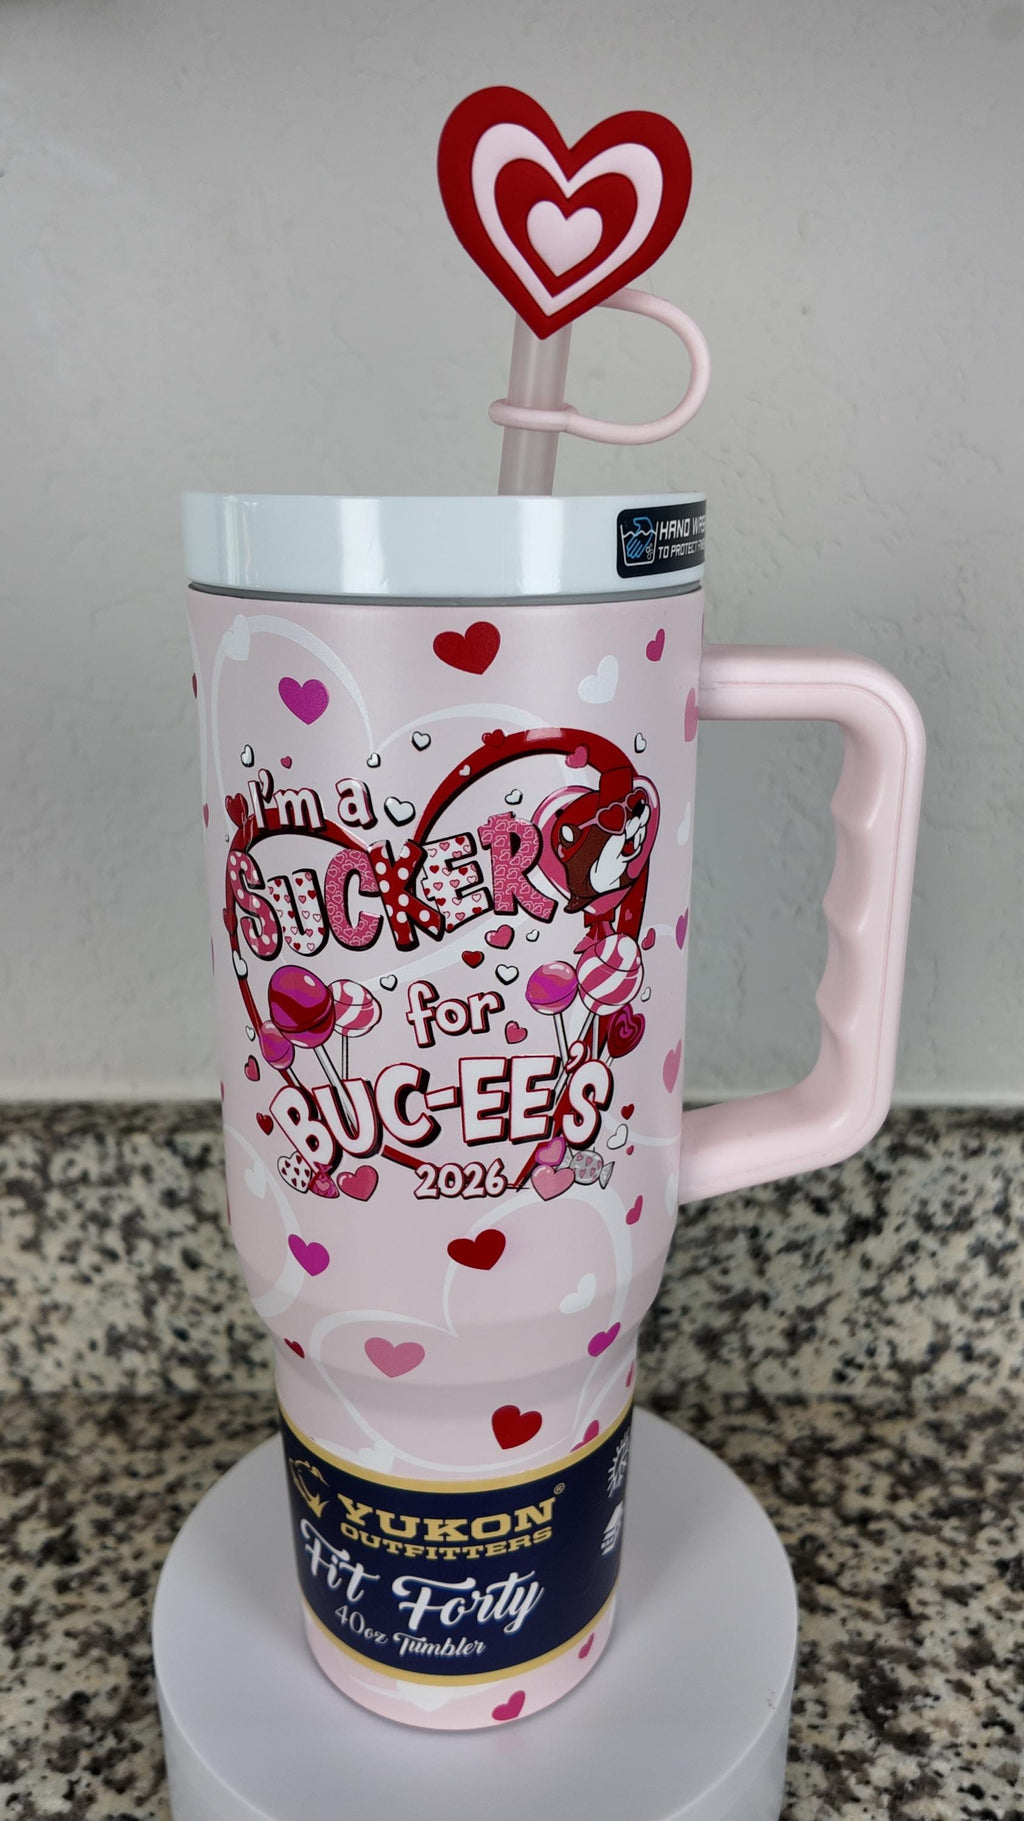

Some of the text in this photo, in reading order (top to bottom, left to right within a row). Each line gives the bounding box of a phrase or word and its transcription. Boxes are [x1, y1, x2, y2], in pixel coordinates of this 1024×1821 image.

[658, 546, 669, 560] TO
[670, 540, 698, 558] PROTECT
[659, 518, 690, 541] HAND
[336, 777, 376, 828] a
[228, 812, 558, 960] SUCKER
[406, 980, 505, 1047] for
[270, 1040, 613, 1168] BUC-EE'S
[414, 1161, 509, 1199] 2026
[340, 1526, 553, 1561] OUTFITTERS
[300, 1519, 544, 1634] Fit Forty
[334, 1605, 486, 1657] 40oz Tumbler
